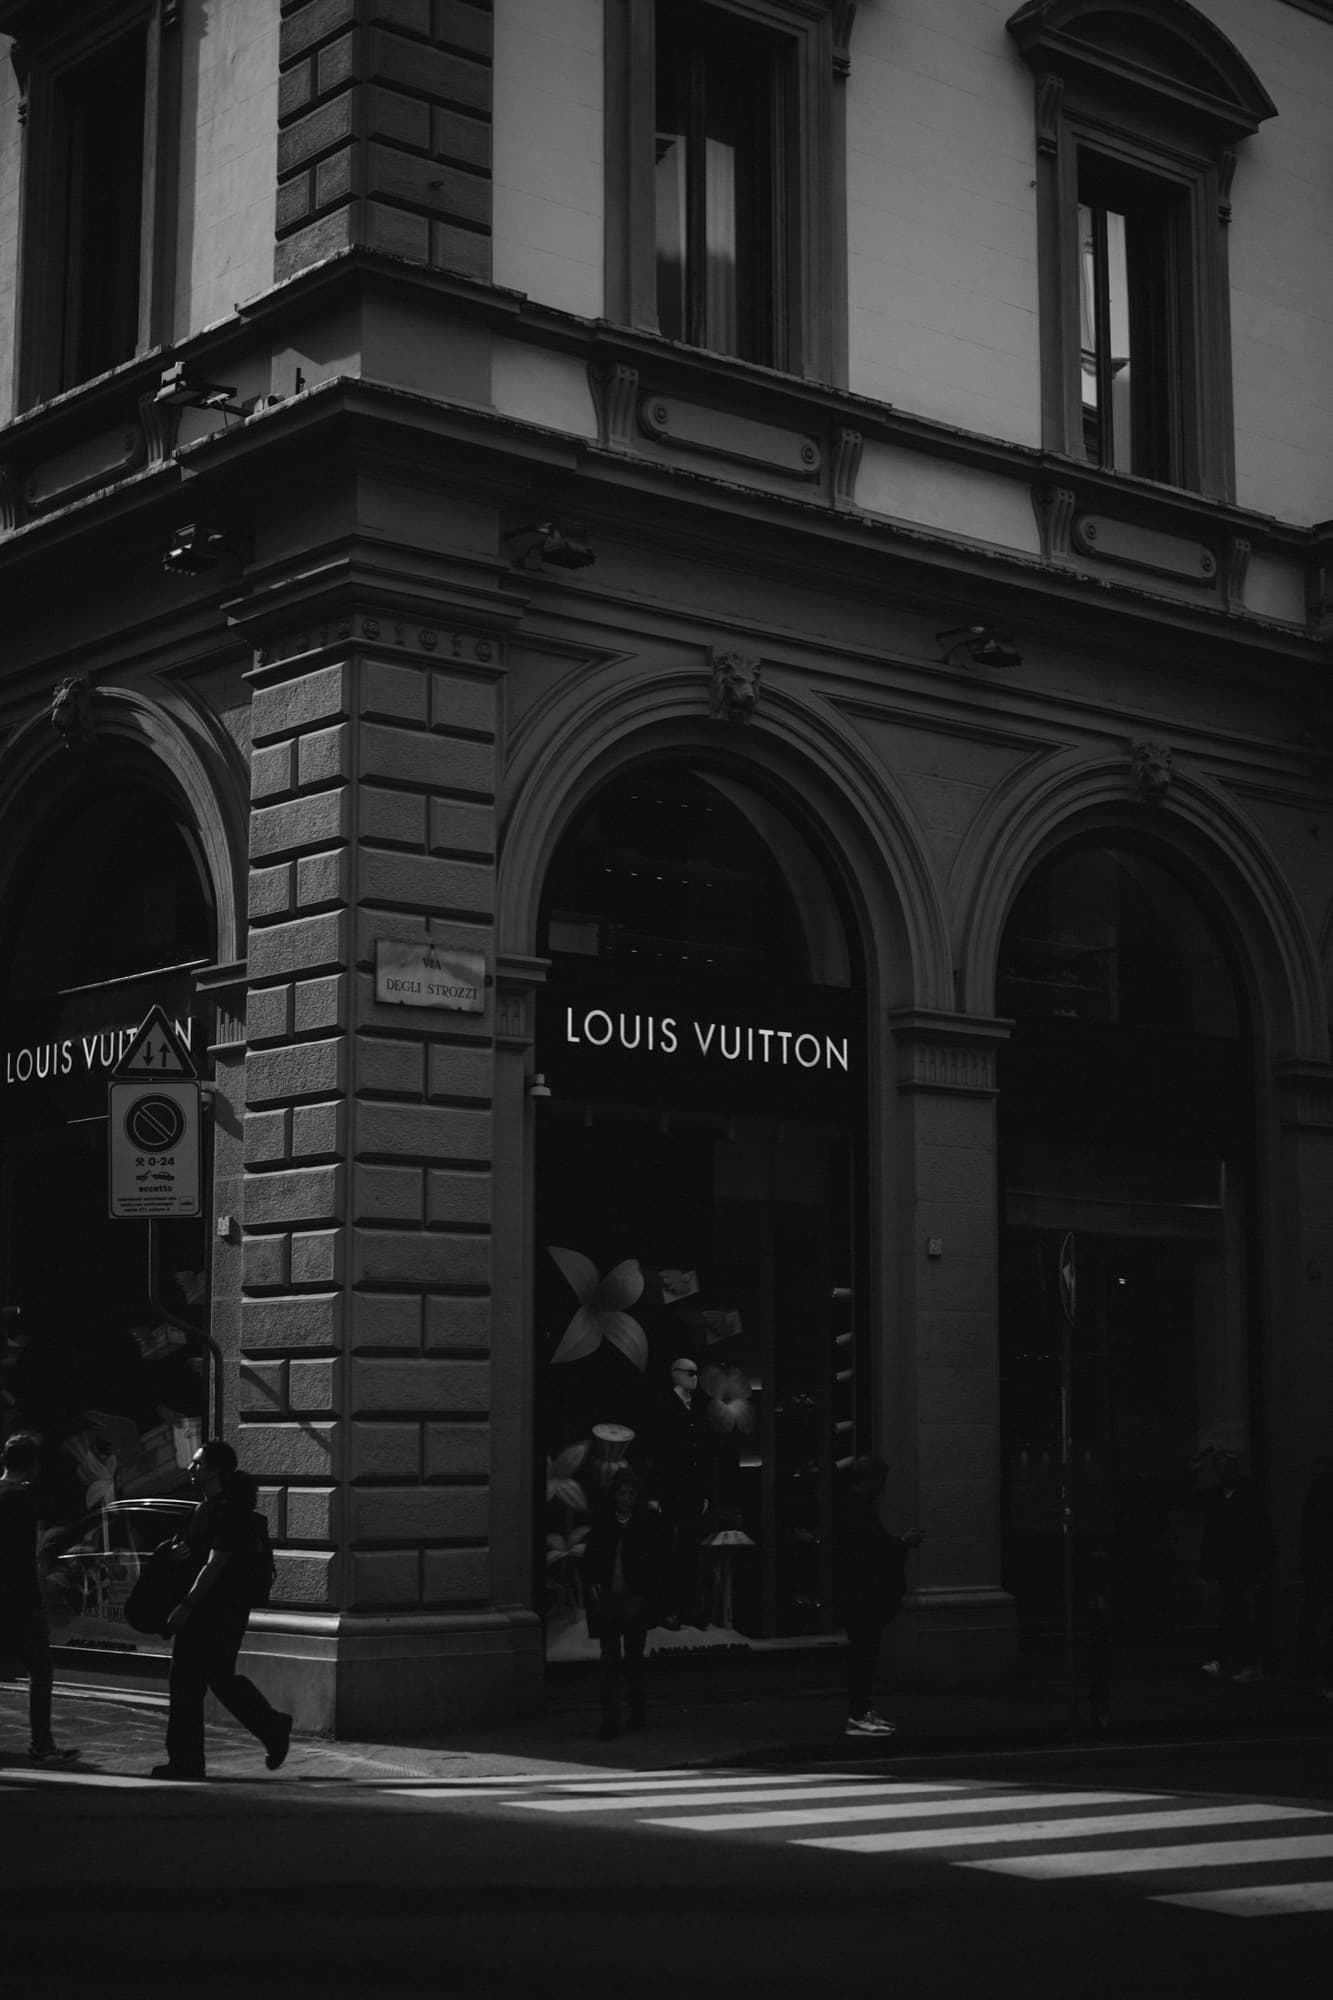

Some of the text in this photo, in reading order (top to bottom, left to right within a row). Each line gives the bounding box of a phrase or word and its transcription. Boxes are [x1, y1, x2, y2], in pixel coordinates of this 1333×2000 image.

[422, 957, 442, 970] VIA
[386, 978, 477, 1000] DEGLI STROZZI
[7, 1016, 192, 1084] LOUIS VUITN
[566, 1006, 849, 1072] LOUIS VUITTON
[148, 1156, 175, 1166] 0-24
